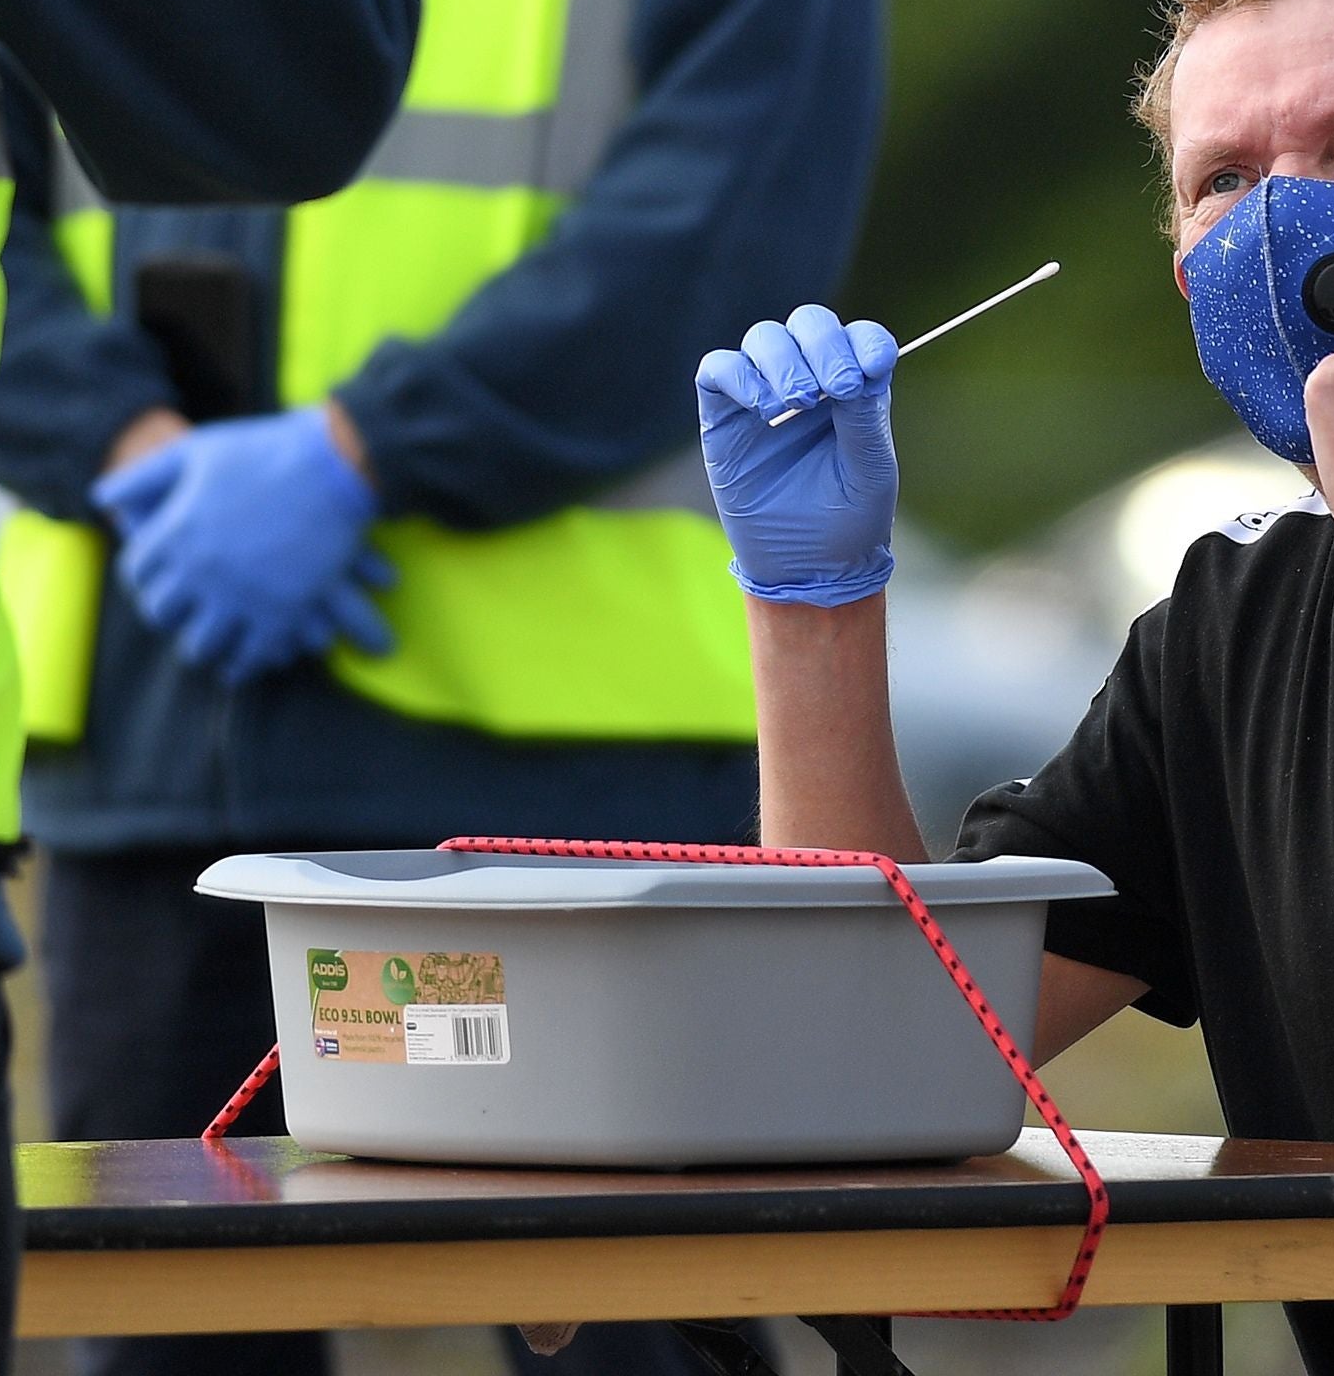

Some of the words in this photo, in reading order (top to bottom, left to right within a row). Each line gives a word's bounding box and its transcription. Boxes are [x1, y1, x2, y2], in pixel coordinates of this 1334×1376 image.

[319, 1007, 339, 1022] ECO
[341, 1009, 364, 1024] 9.5L
[366, 1010, 402, 1025] BOWL
